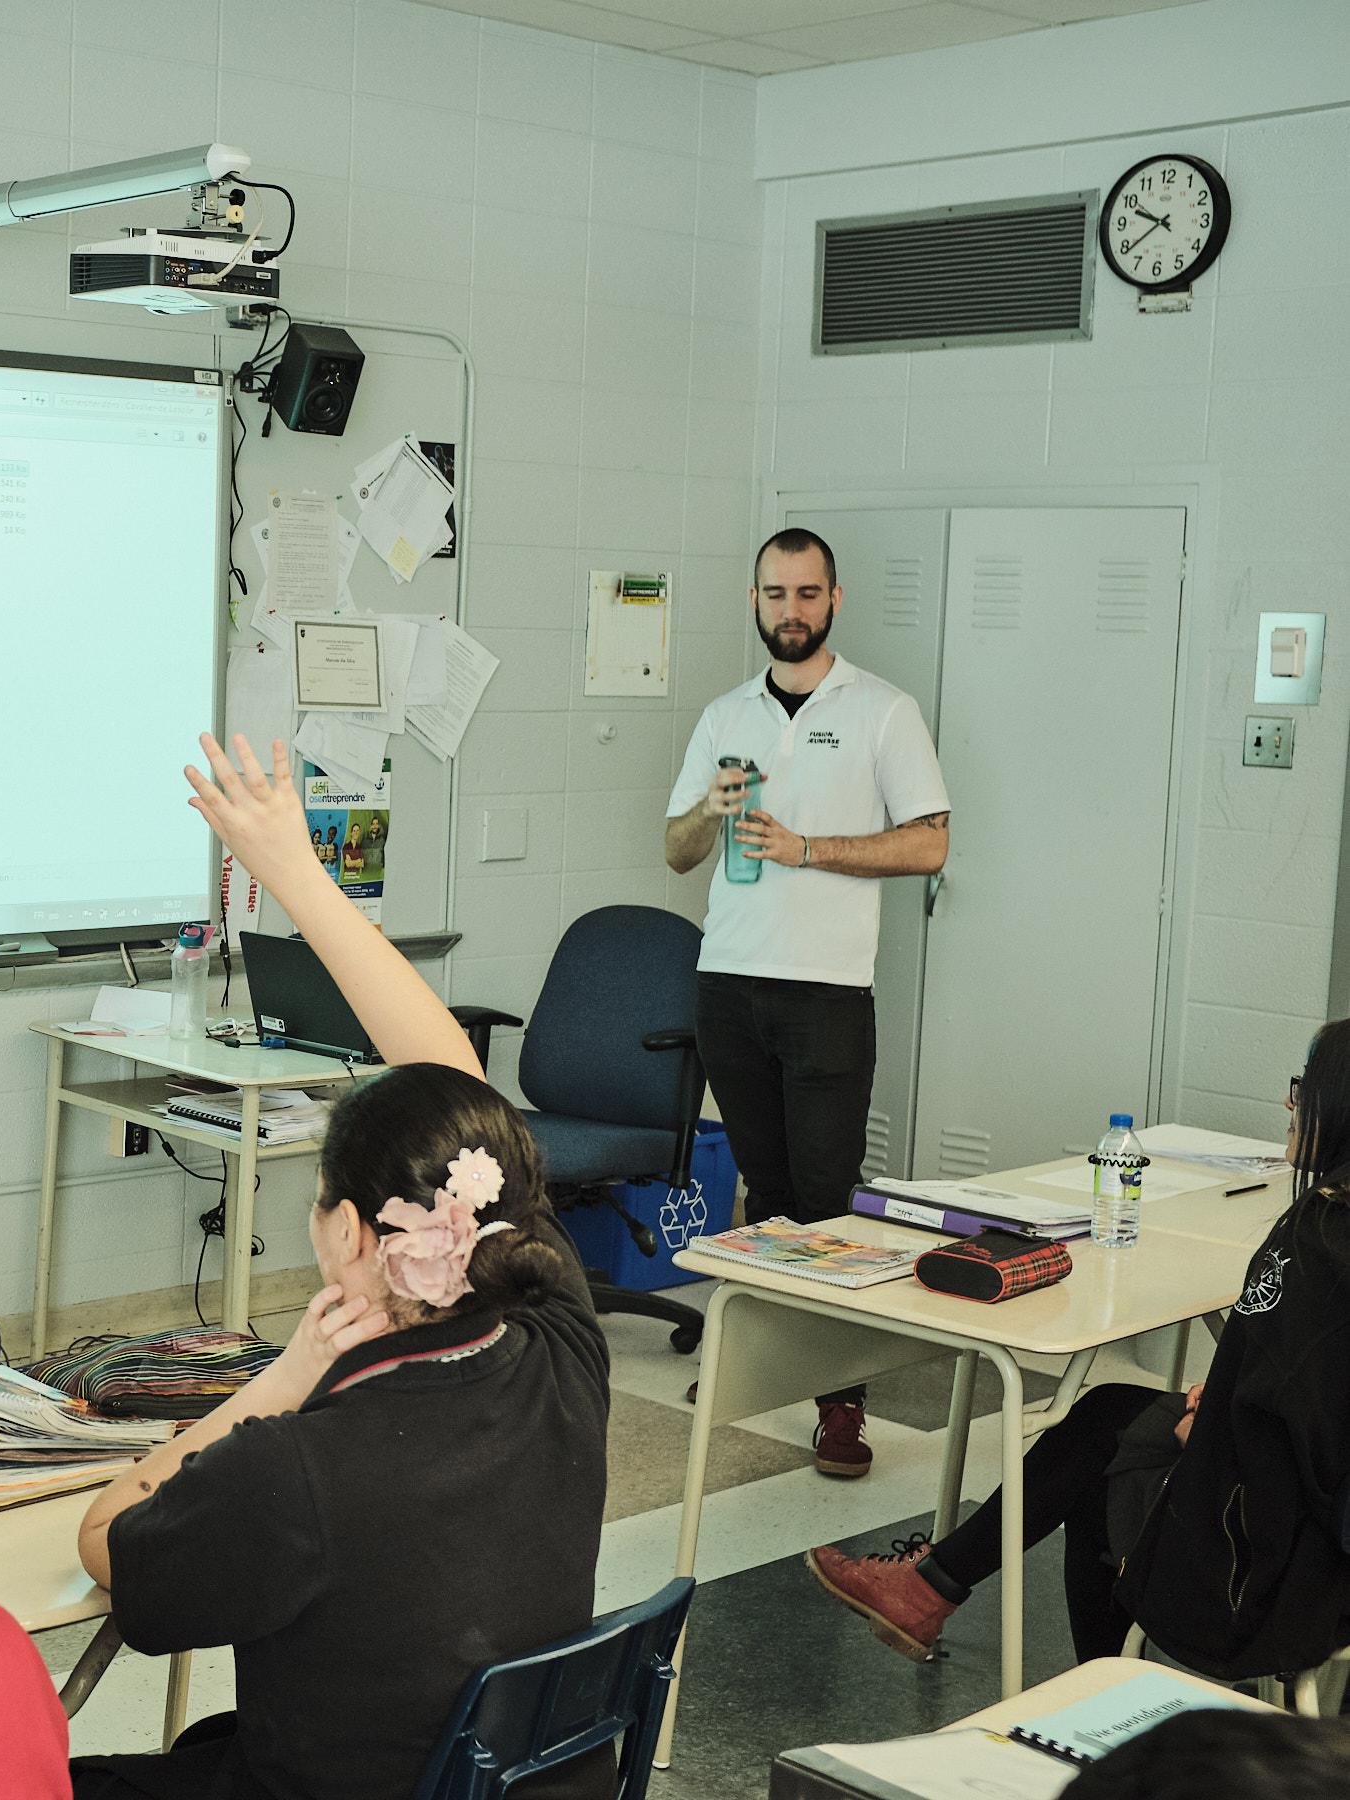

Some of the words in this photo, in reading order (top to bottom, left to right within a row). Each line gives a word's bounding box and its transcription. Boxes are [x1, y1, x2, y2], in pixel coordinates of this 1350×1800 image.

[1141, 176, 1153, 191] 11
[1161, 169, 1177, 184] 12
[1187, 173, 1193, 188] 1
[1124, 194, 1138, 209] 10
[1197, 190, 1208, 206] 2
[1117, 216, 1127, 231] 9
[1200, 213, 1210, 228] 3
[1120, 239, 1130, 255] 8
[1191, 238, 1201, 253] 4
[1133, 255, 1143, 271] 7
[1152, 260, 1162, 277] 6
[1174, 254, 1184, 270] 5
[311, 780, 329, 794] défi
[1086, 1727, 1114, 1741] Vie
[1116, 1696, 1187, 1735] quotidienne
